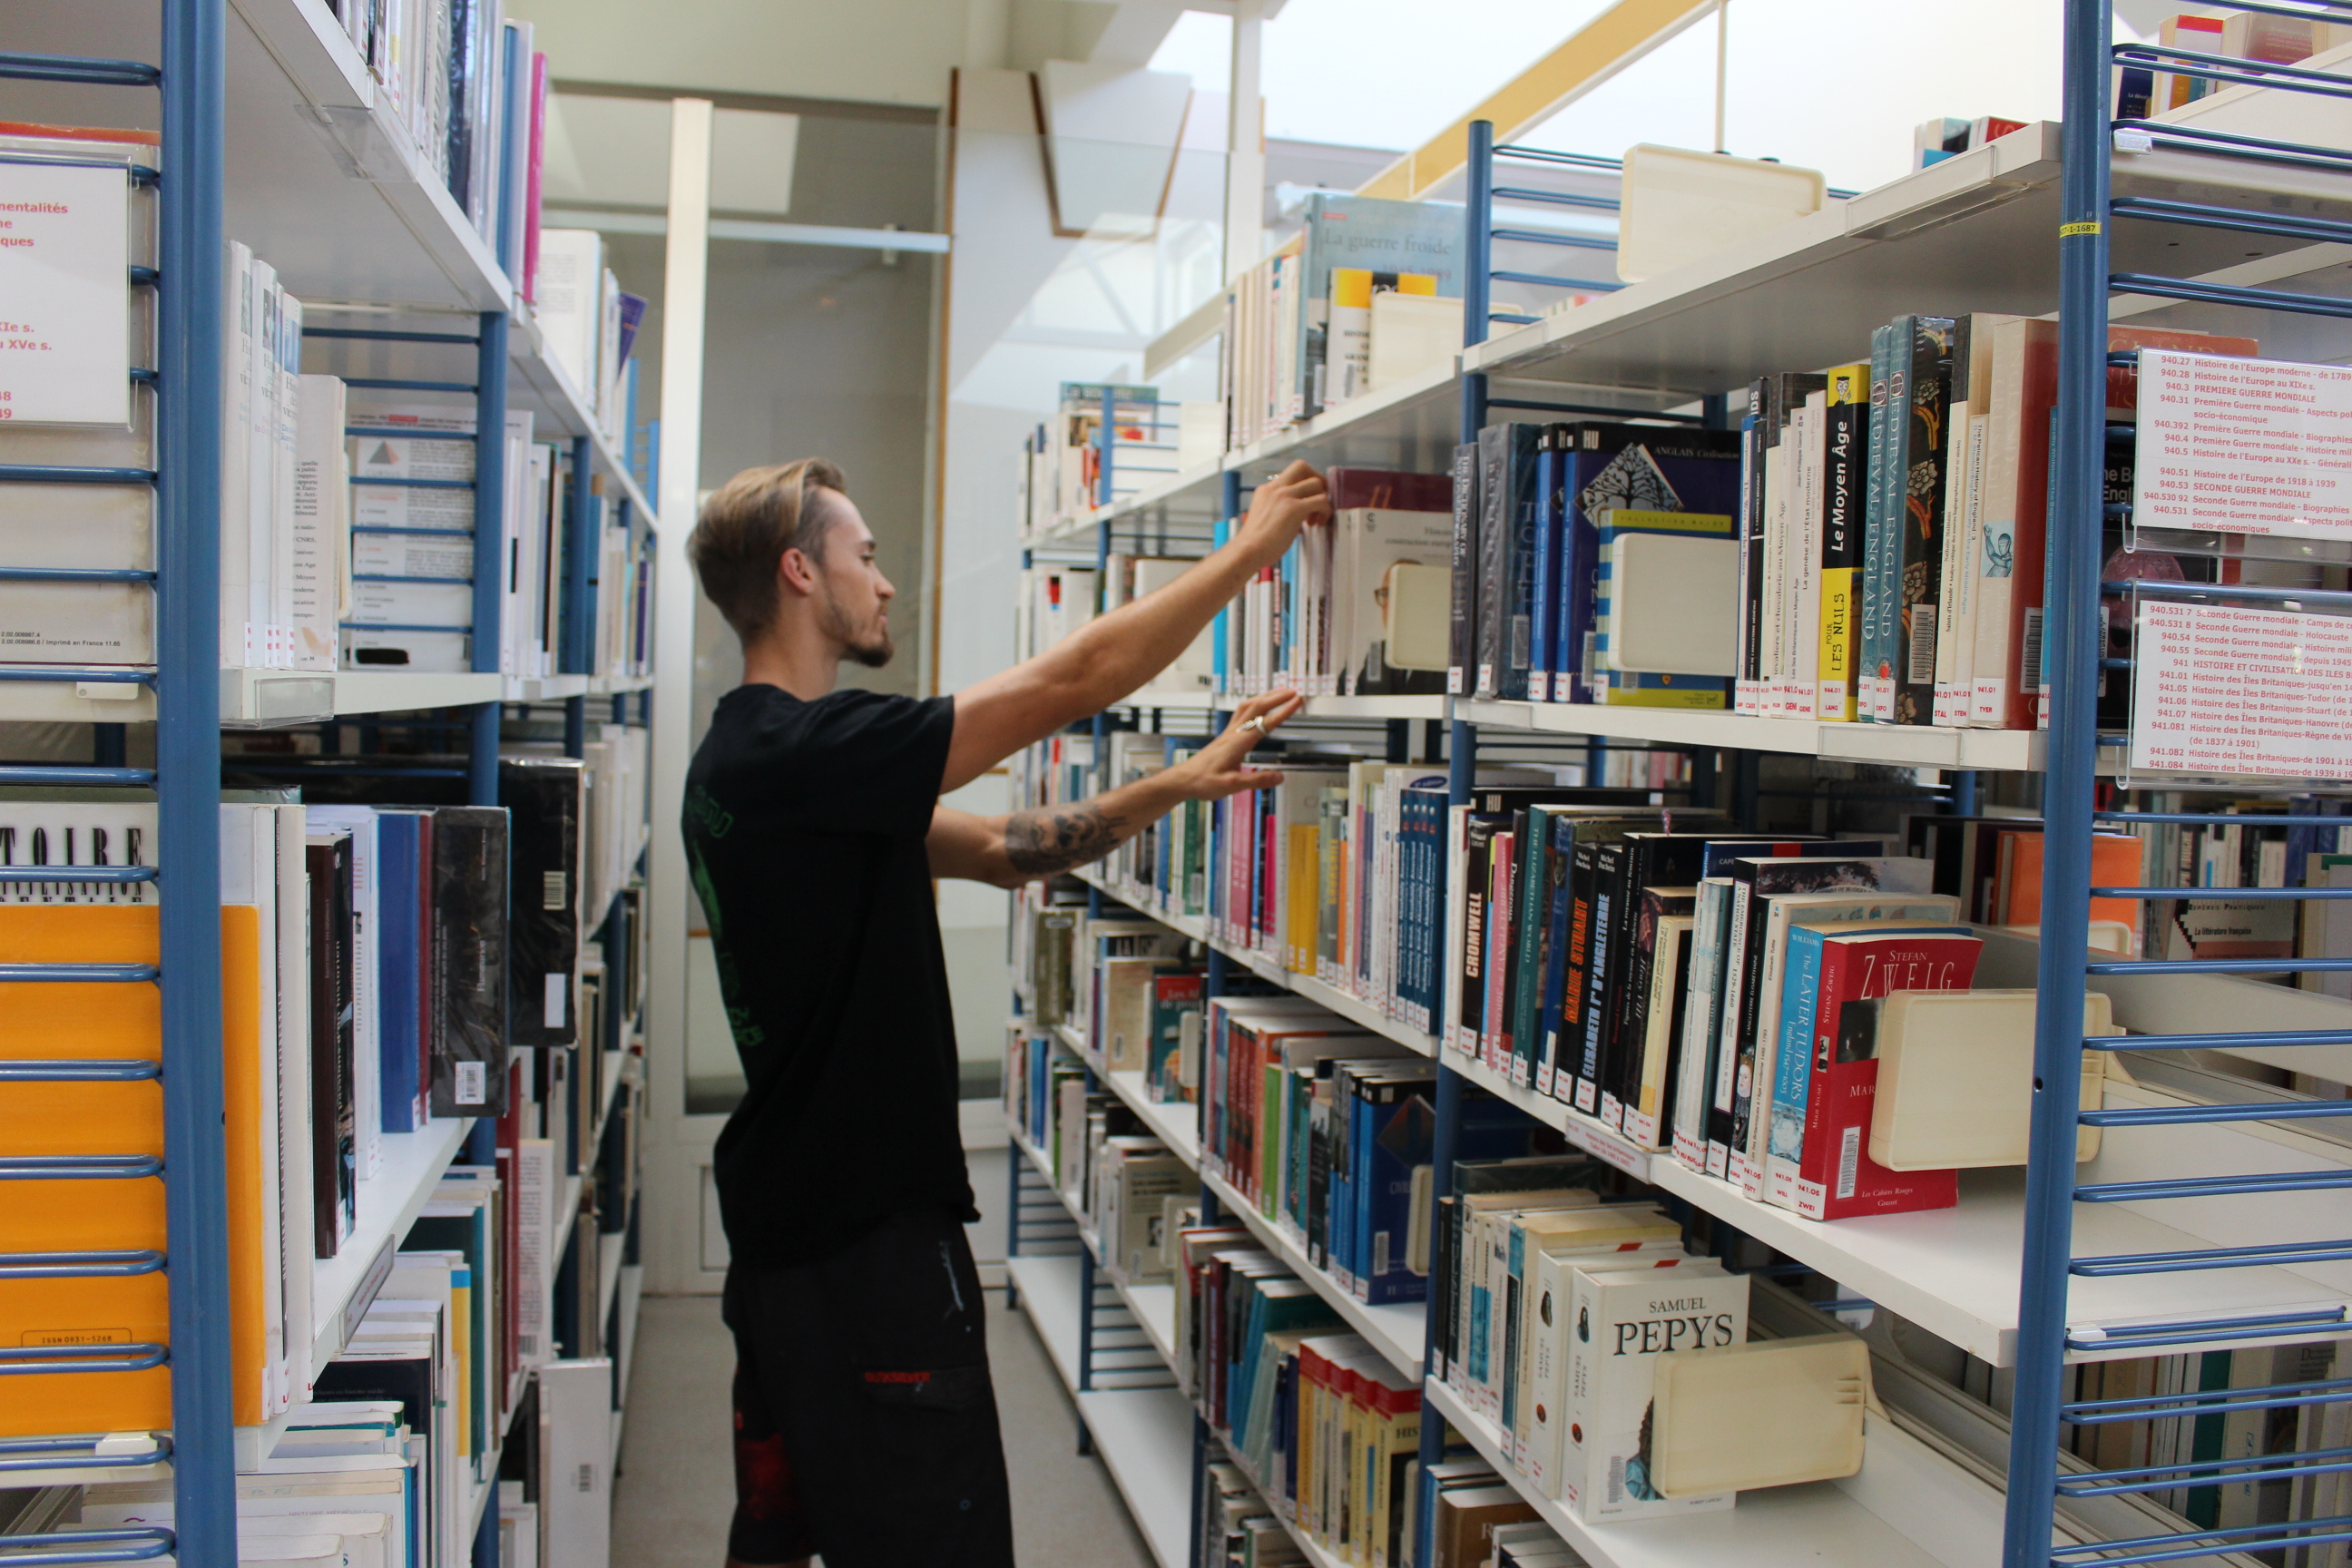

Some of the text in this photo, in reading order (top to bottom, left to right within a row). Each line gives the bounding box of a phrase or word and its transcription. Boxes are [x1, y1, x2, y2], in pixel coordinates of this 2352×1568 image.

[1324, 229, 1452, 254] La guerre froide
[40, 341, 53, 350] s.
[2160, 368, 2190, 378] 940.28
[2193, 371, 2227, 382] Histoire
[2229, 374, 2239, 383] de
[2240, 376, 2275, 387] l'Europe
[2276, 379, 2287, 387] au
[2161, 355, 2351, 380] 940.27 Histoire de l'Europe moderne de 1789
[2165, 381, 2316, 403] 940.3 PREMIERE GUERRE MONDIALE
[2160, 393, 2337, 417] 940.31 Première Guerre mondiale Aspects
[2193, 411, 2268, 424] socio-économique
[2153, 418, 2298, 439] 940.392 Première Guerre mondiale
[1655, 446, 1694, 457] ANGLAIS
[1831, 421, 1850, 552] Le Moyen Âge
[1973, 466, 1981, 493] History
[2159, 466, 2336, 488] 940.51 Histoire de l'Europe de 1918 à 1939
[2159, 479, 2310, 498] 940.53 SECONDE GUERRE MONDIALE
[2143, 491, 2349, 514] 940.530 92 Seconde Guerre mondiale Biographies
[2191, 522, 2269, 534] socio-économiques
[1864, 523, 1880, 641] ENGLAND
[1882, 515, 1896, 637] ENGLAND
[1831, 593, 1845, 671] LES NULS
[2149, 617, 2348, 641] 940.531 8 Seconde Guerre mondiale Holocauste
[45, 639, 71, 647] Imprimé
[2172, 658, 2344, 679] 941 HISTOIRE ET DES ILES
[2158, 682, 2187, 692] 941.05
[2191, 685, 2223, 695] Histoire
[2225, 687, 2240, 696] des
[2259, 690, 2330, 702] Britaniques-Tudor
[2205, 737, 2226, 746] 1837
[2227, 738, 2233, 746] à
[1465, 892, 1483, 978] CROMWELL
[2194, 927, 2201, 936] La
[1564, 897, 1588, 1024] MARIE STUART
[1889, 950, 1928, 962] STEFAN
[1582, 893, 1610, 1080] ELISABETH D'ANGLETERRE
[1730, 968, 1738, 1008] 1529-1660
[1823, 965, 1835, 1024] STEFAN ZWEIG
[1786, 1022, 1797, 1051] England
[1791, 955, 1814, 1101] The LATER TUDORS
[1744, 1167, 1761, 1180] 941.05
[1775, 1172, 1792, 1183] 941.05
[1744, 1183, 1757, 1193] TUTT
[1777, 1189, 1788, 1198] WILL
[1798, 1183, 1820, 1197] 941.05
[1873, 1189, 1893, 1198] Cahiers
[1895, 1187, 1914, 1196] Rouges
[1798, 1201, 1815, 1212] ZWEI
[1877, 1199, 1898, 1207] Grasset
[1649, 1298, 1707, 1314] SAMUEL
[1613, 1314, 1734, 1356] PEPYS
